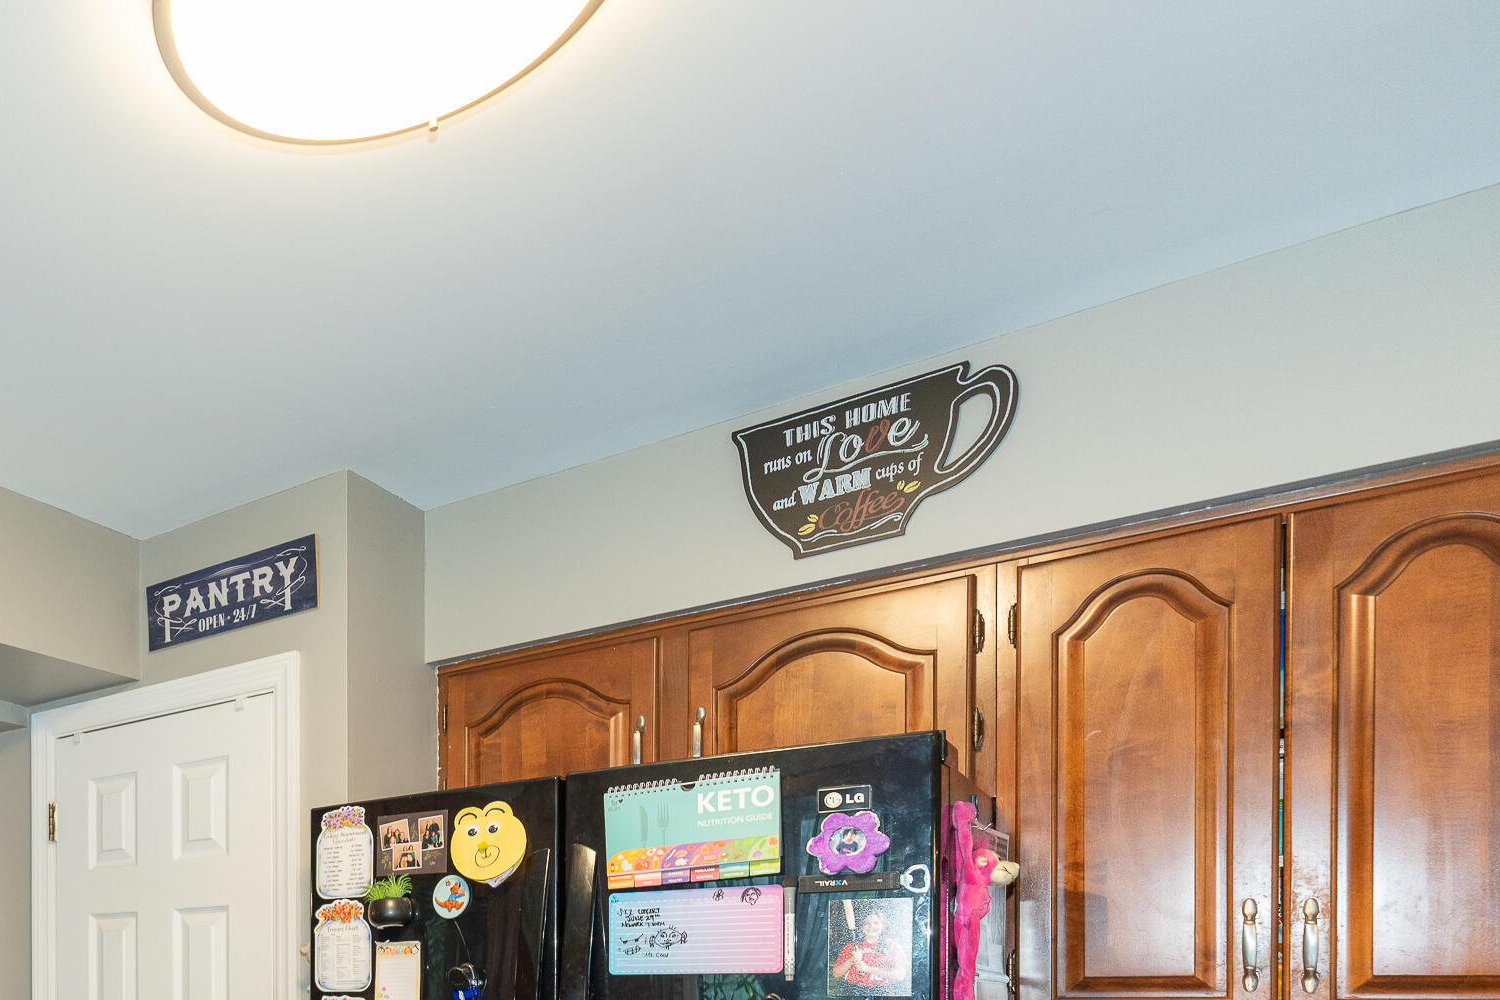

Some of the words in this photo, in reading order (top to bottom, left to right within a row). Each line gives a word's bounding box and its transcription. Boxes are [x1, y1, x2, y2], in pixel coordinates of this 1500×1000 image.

[783, 414, 836, 447] THIS
[845, 392, 912, 429] HOME
[763, 455, 792, 475] runs
[795, 449, 812, 465] on
[805, 417, 921, 482] Love
[772, 490, 797, 511] and
[798, 467, 871, 505] WARM
[875, 461, 904, 482] cups
[908, 452, 924, 476] of
[818, 487, 905, 533] Coffee
[162, 556, 298, 643] PANTRY
[198, 612, 225, 632] OPEN
[233, 604, 256, 623] 24/7
[697, 785, 775, 814] KETO
[698, 814, 745, 828] NUTRITION
[746, 812, 773, 822] GUIDE
[845, 792, 865, 804] LG
